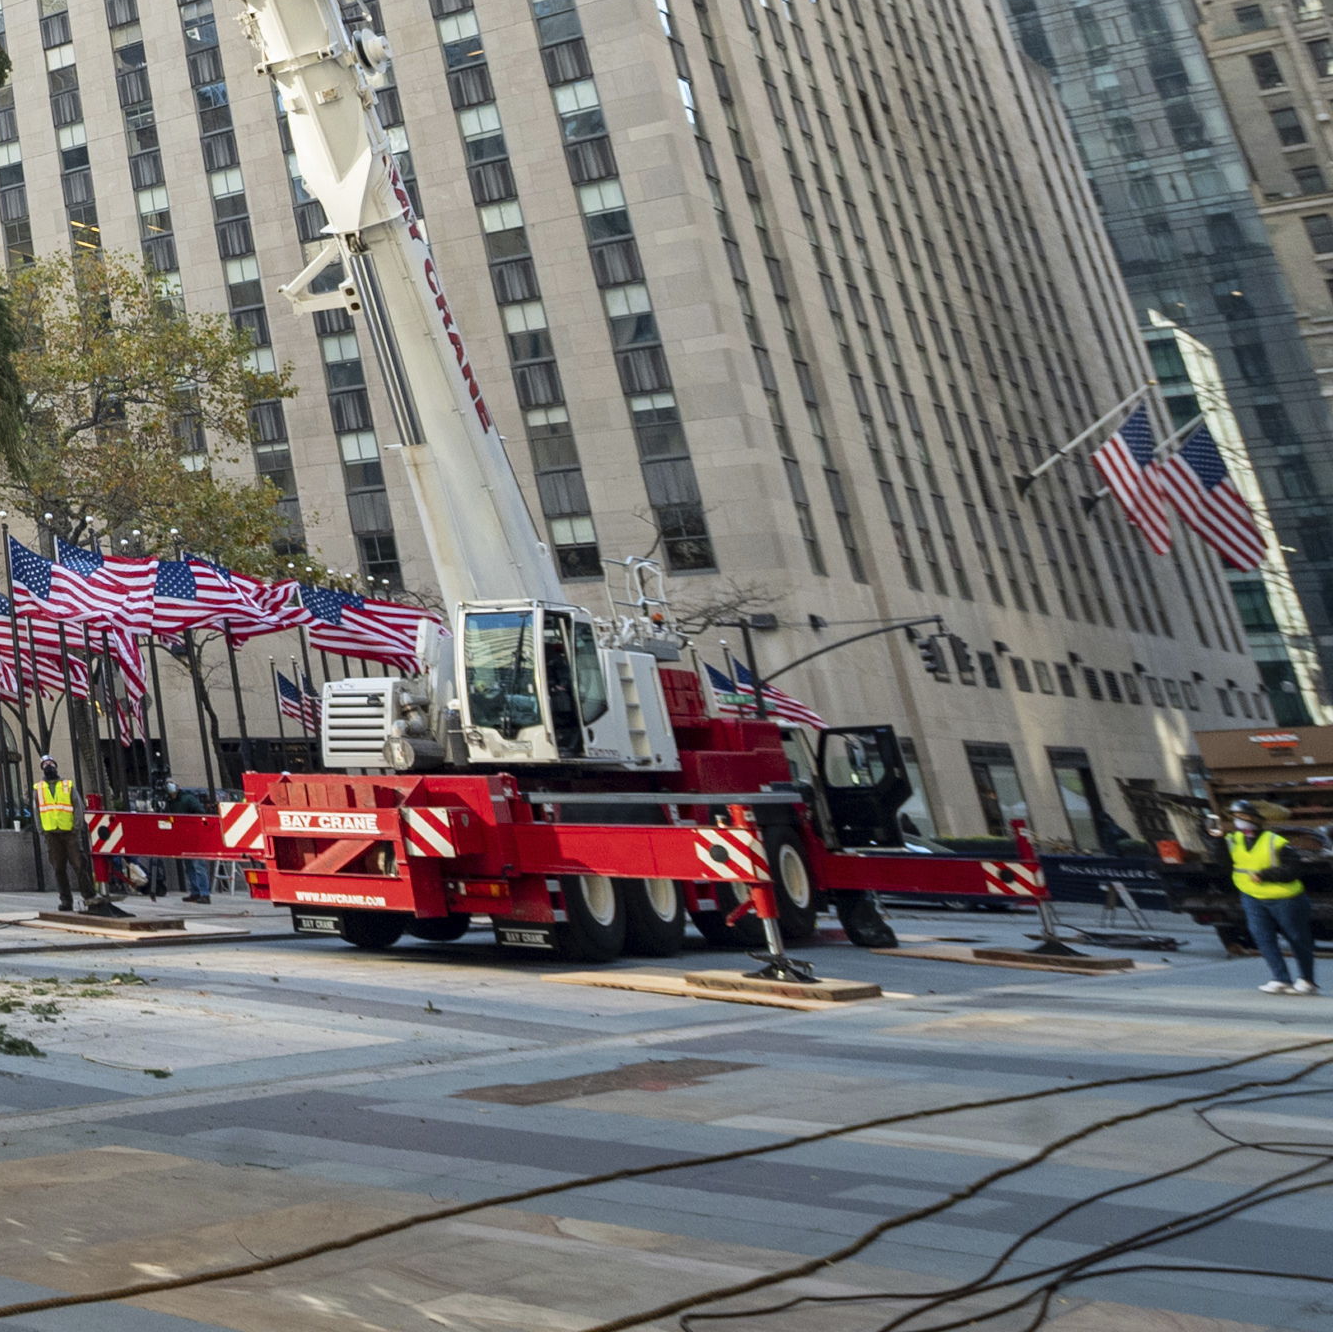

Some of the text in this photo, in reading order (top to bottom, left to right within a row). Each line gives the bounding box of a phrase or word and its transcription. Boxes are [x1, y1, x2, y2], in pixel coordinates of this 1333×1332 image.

[424, 257, 494, 435] CRANE
[279, 815, 377, 830] BAY CRANE
[295, 891, 386, 907] WWW.BAYCRANE.COM
[315, 920, 335, 930] CRANE
